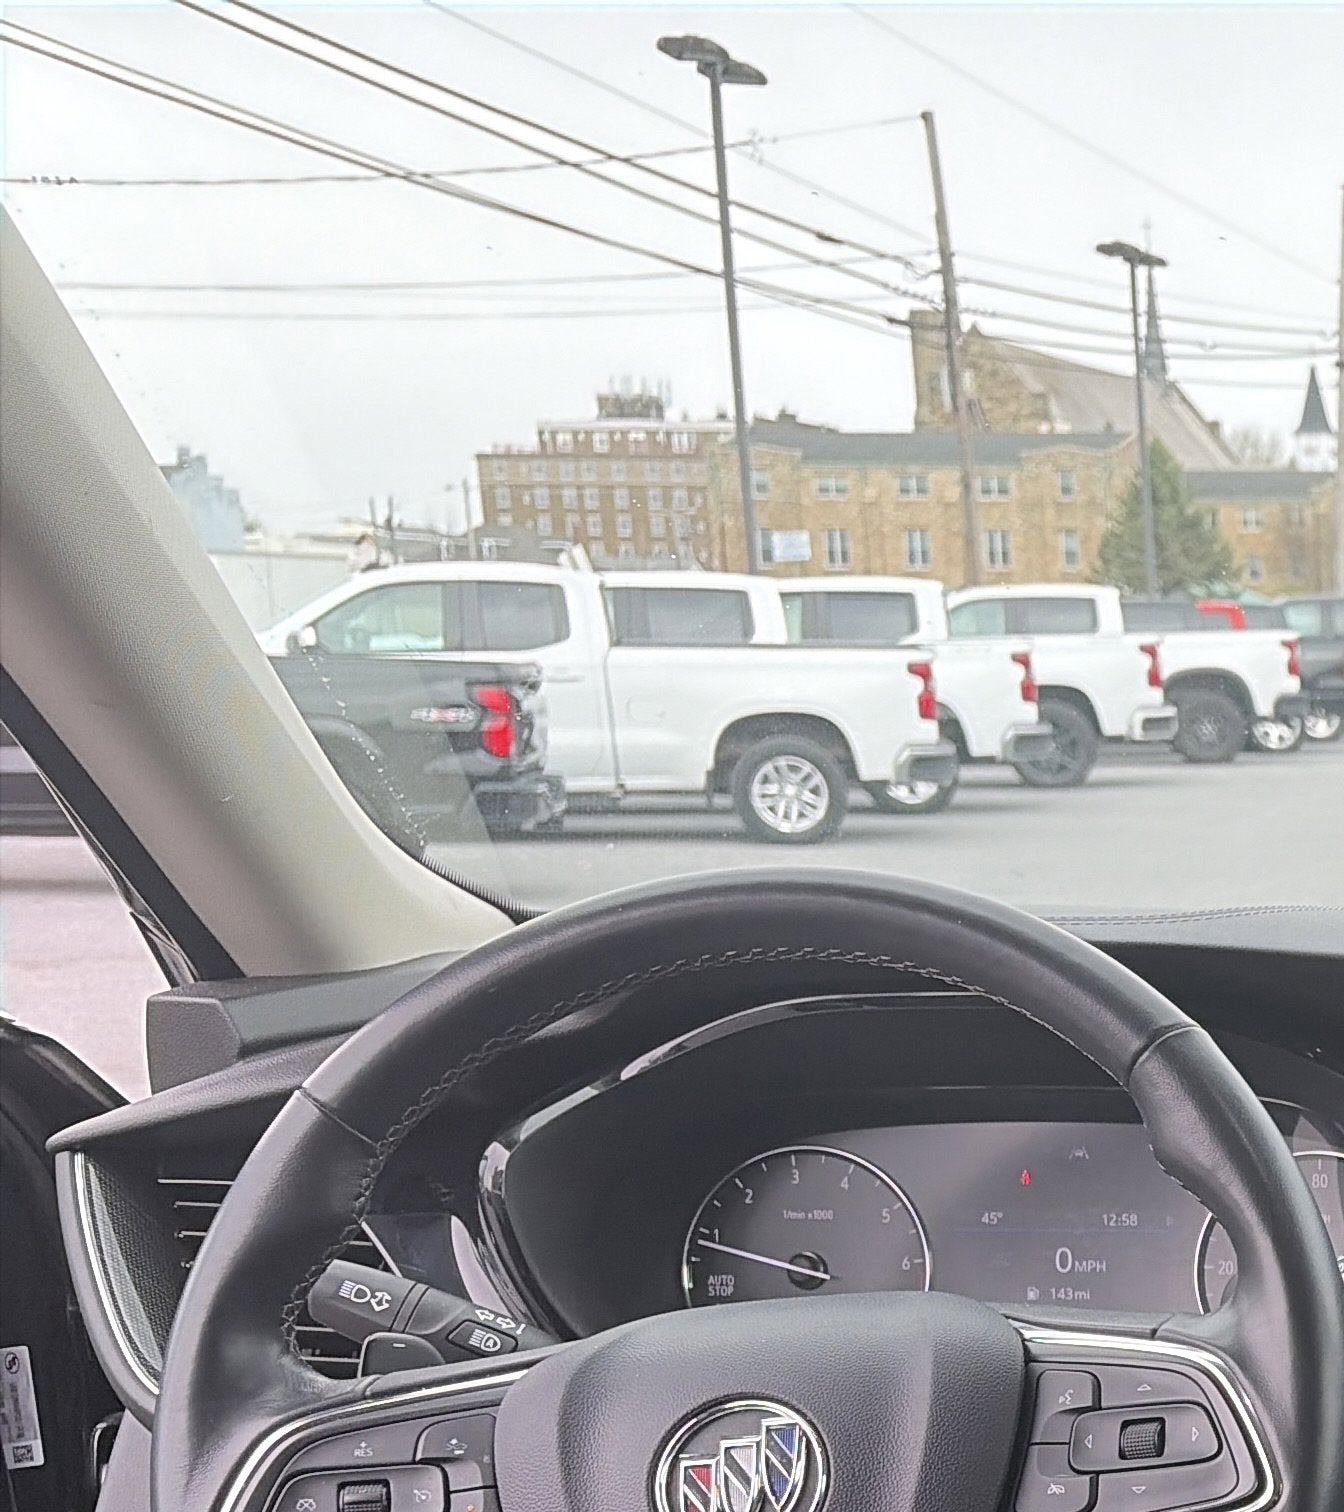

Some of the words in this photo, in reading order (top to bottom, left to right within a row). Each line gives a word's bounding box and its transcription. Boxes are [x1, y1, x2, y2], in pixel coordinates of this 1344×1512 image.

[791, 1169, 799, 1184] 3
[840, 1177, 849, 1190] 4
[1312, 1173, 1328, 1189] 80
[745, 1190, 753, 1204] 2
[882, 1209, 890, 1223] 5
[981, 1212, 1003, 1226] 45°
[1102, 1213, 1138, 1227] 12:58
[713, 1229, 719, 1242] 1
[902, 1257, 910, 1270] 6
[1055, 1247, 1072, 1273] 0
[1075, 1259, 1106, 1272] MPH
[1218, 1260, 1233, 1275] 20
[708, 1275, 734, 1286] AUTO
[708, 1286, 734, 1296] STOP
[353, 1447, 373, 1458] RES
